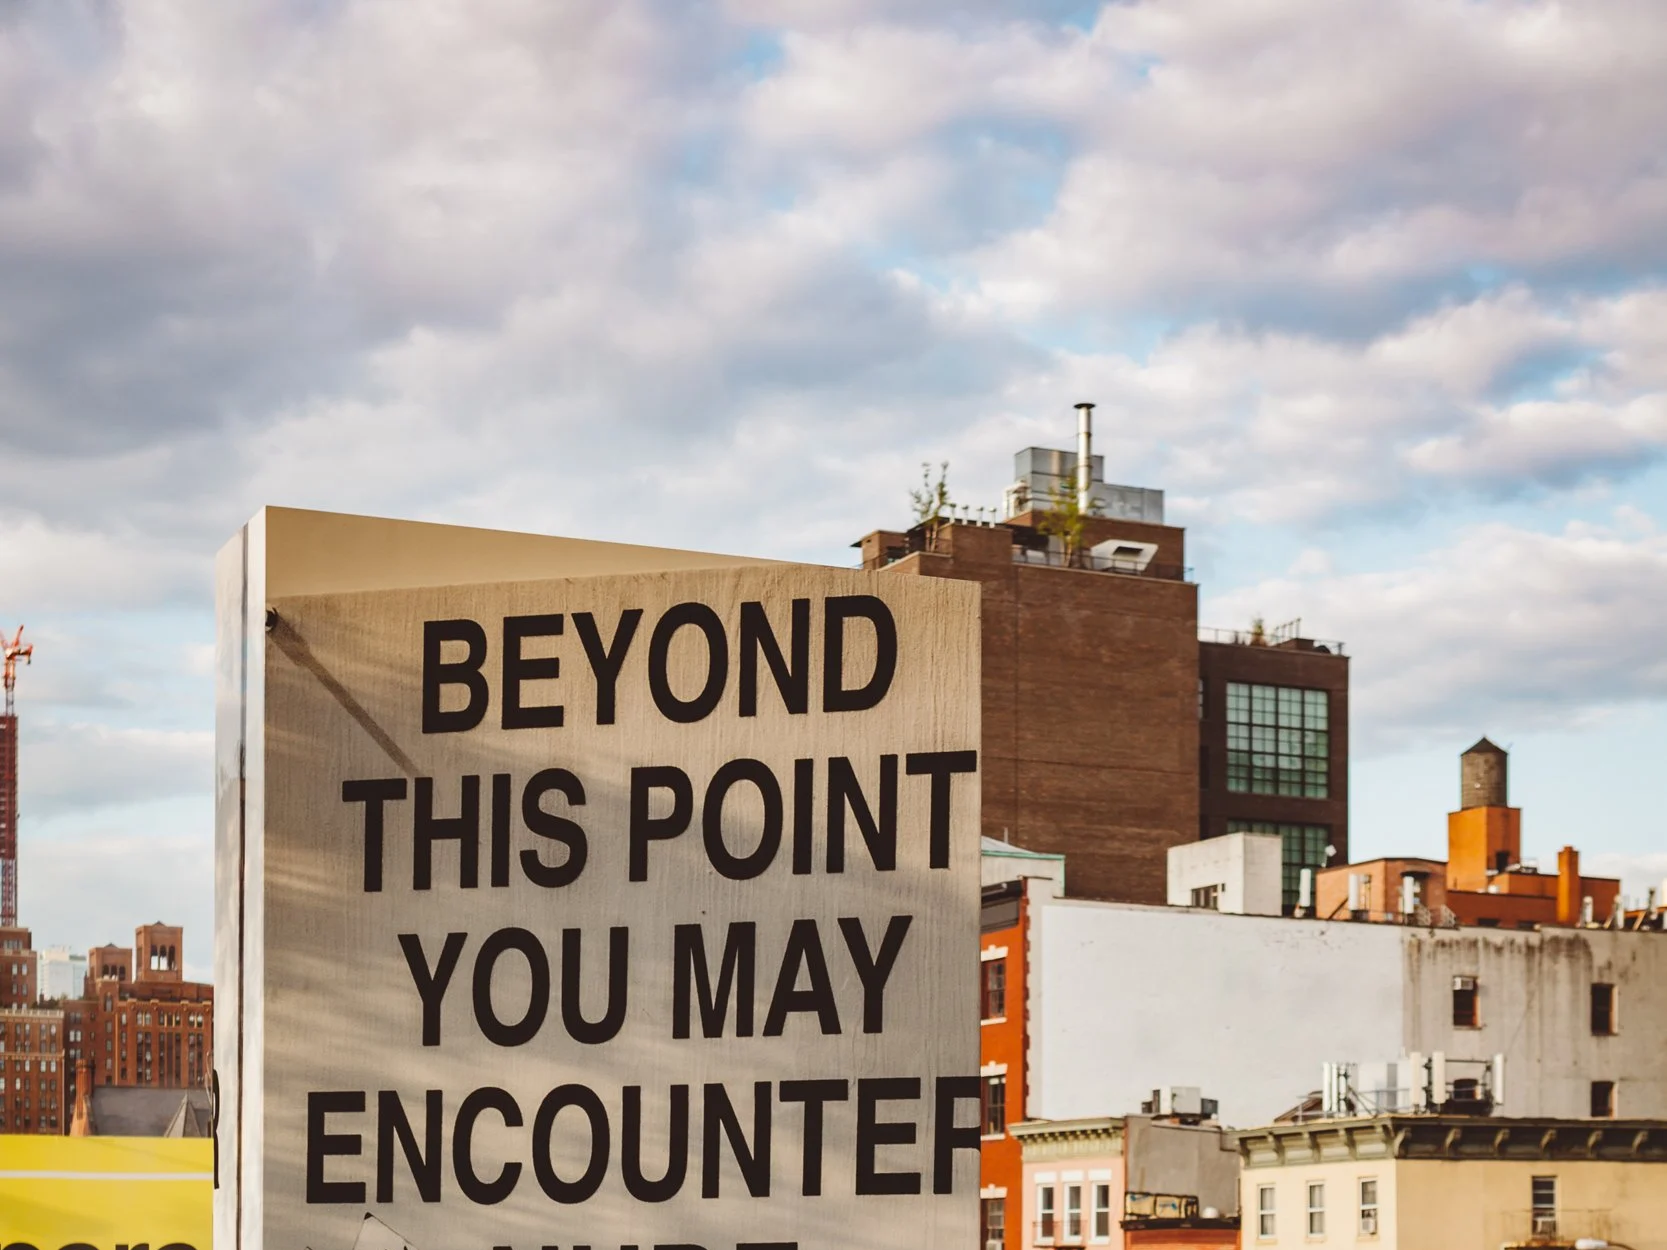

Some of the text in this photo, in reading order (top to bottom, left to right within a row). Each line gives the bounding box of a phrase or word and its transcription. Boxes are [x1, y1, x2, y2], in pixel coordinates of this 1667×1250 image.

[421, 594, 898, 735] BEYOND
[342, 751, 978, 893] THIS POINT
[397, 914, 913, 1047] YOU MAY
